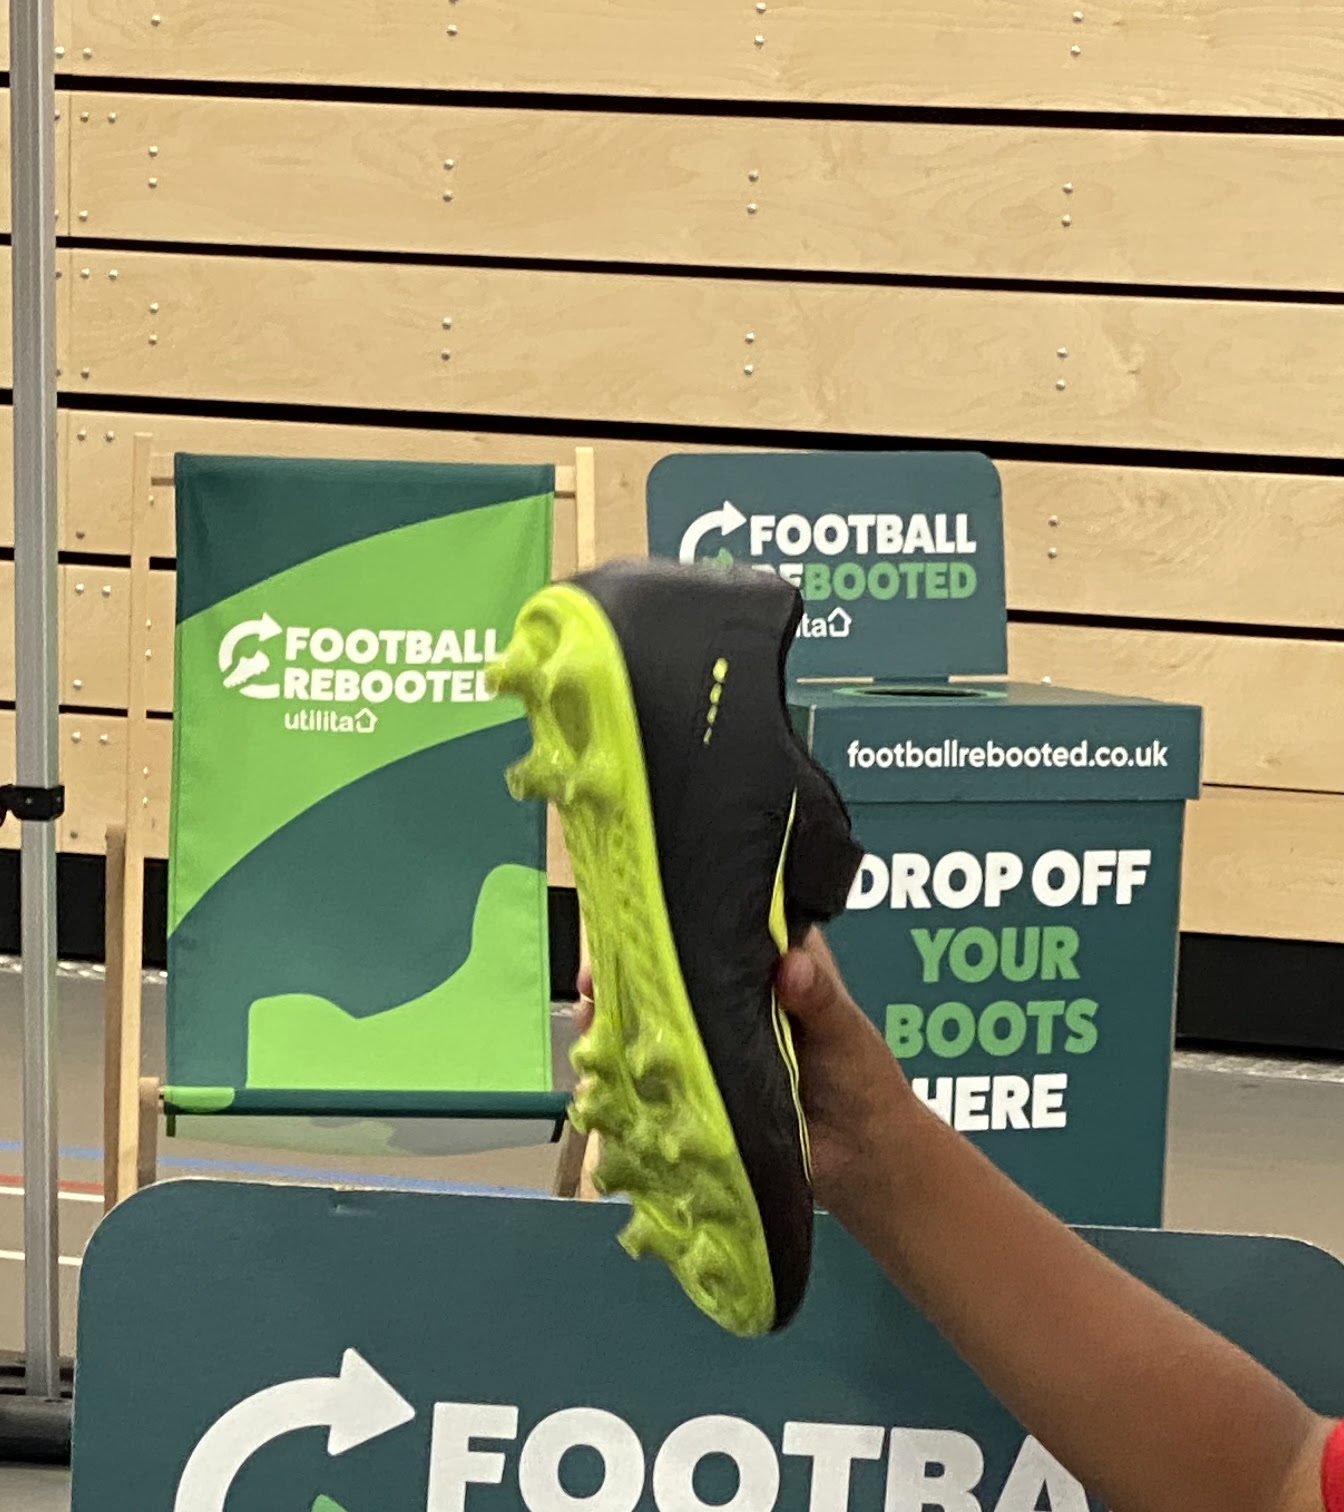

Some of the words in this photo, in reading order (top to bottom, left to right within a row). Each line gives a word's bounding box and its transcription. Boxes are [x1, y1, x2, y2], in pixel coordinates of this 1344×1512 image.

[750, 513, 977, 556] FOOTBALL
[284, 709, 354, 733] utilita
[847, 739, 1169, 769] footballrebooted.co.uk
[846, 851, 1024, 910] DROP
[1031, 849, 1152, 907] OFF
[910, 926, 1081, 984] YOUR
[885, 998, 1099, 1059] BOOTS
